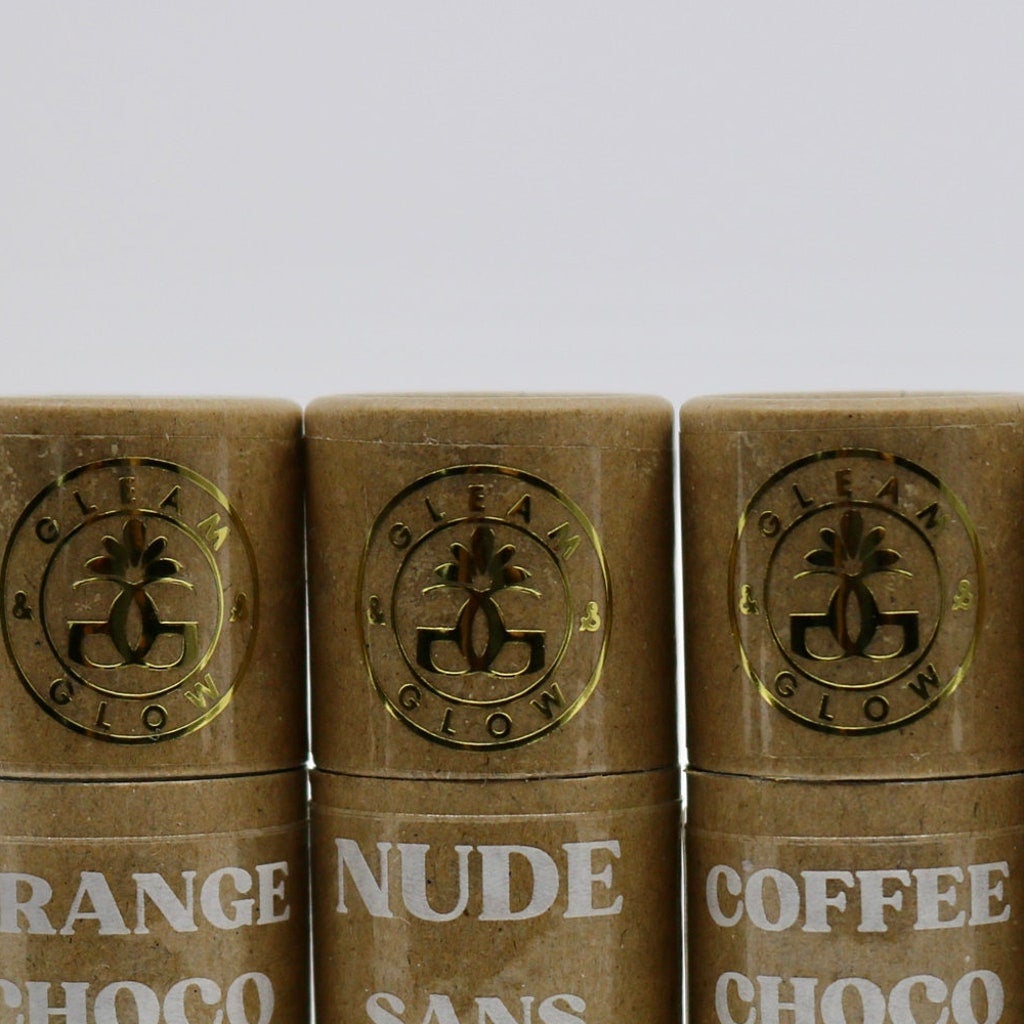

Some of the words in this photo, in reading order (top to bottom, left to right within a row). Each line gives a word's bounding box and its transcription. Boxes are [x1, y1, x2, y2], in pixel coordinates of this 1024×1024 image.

[35, 477, 230, 550] GLEAM
[389, 484, 581, 560] GLEAM
[758, 468, 948, 537] GLEAM
[50, 673, 220, 731] GLOW
[398, 682, 566, 738] GLOW
[774, 663, 940, 722] GLOW
[0, 861, 289, 936] RANGE
[335, 839, 623, 922] NUDE
[706, 861, 1011, 932] COFFEE
